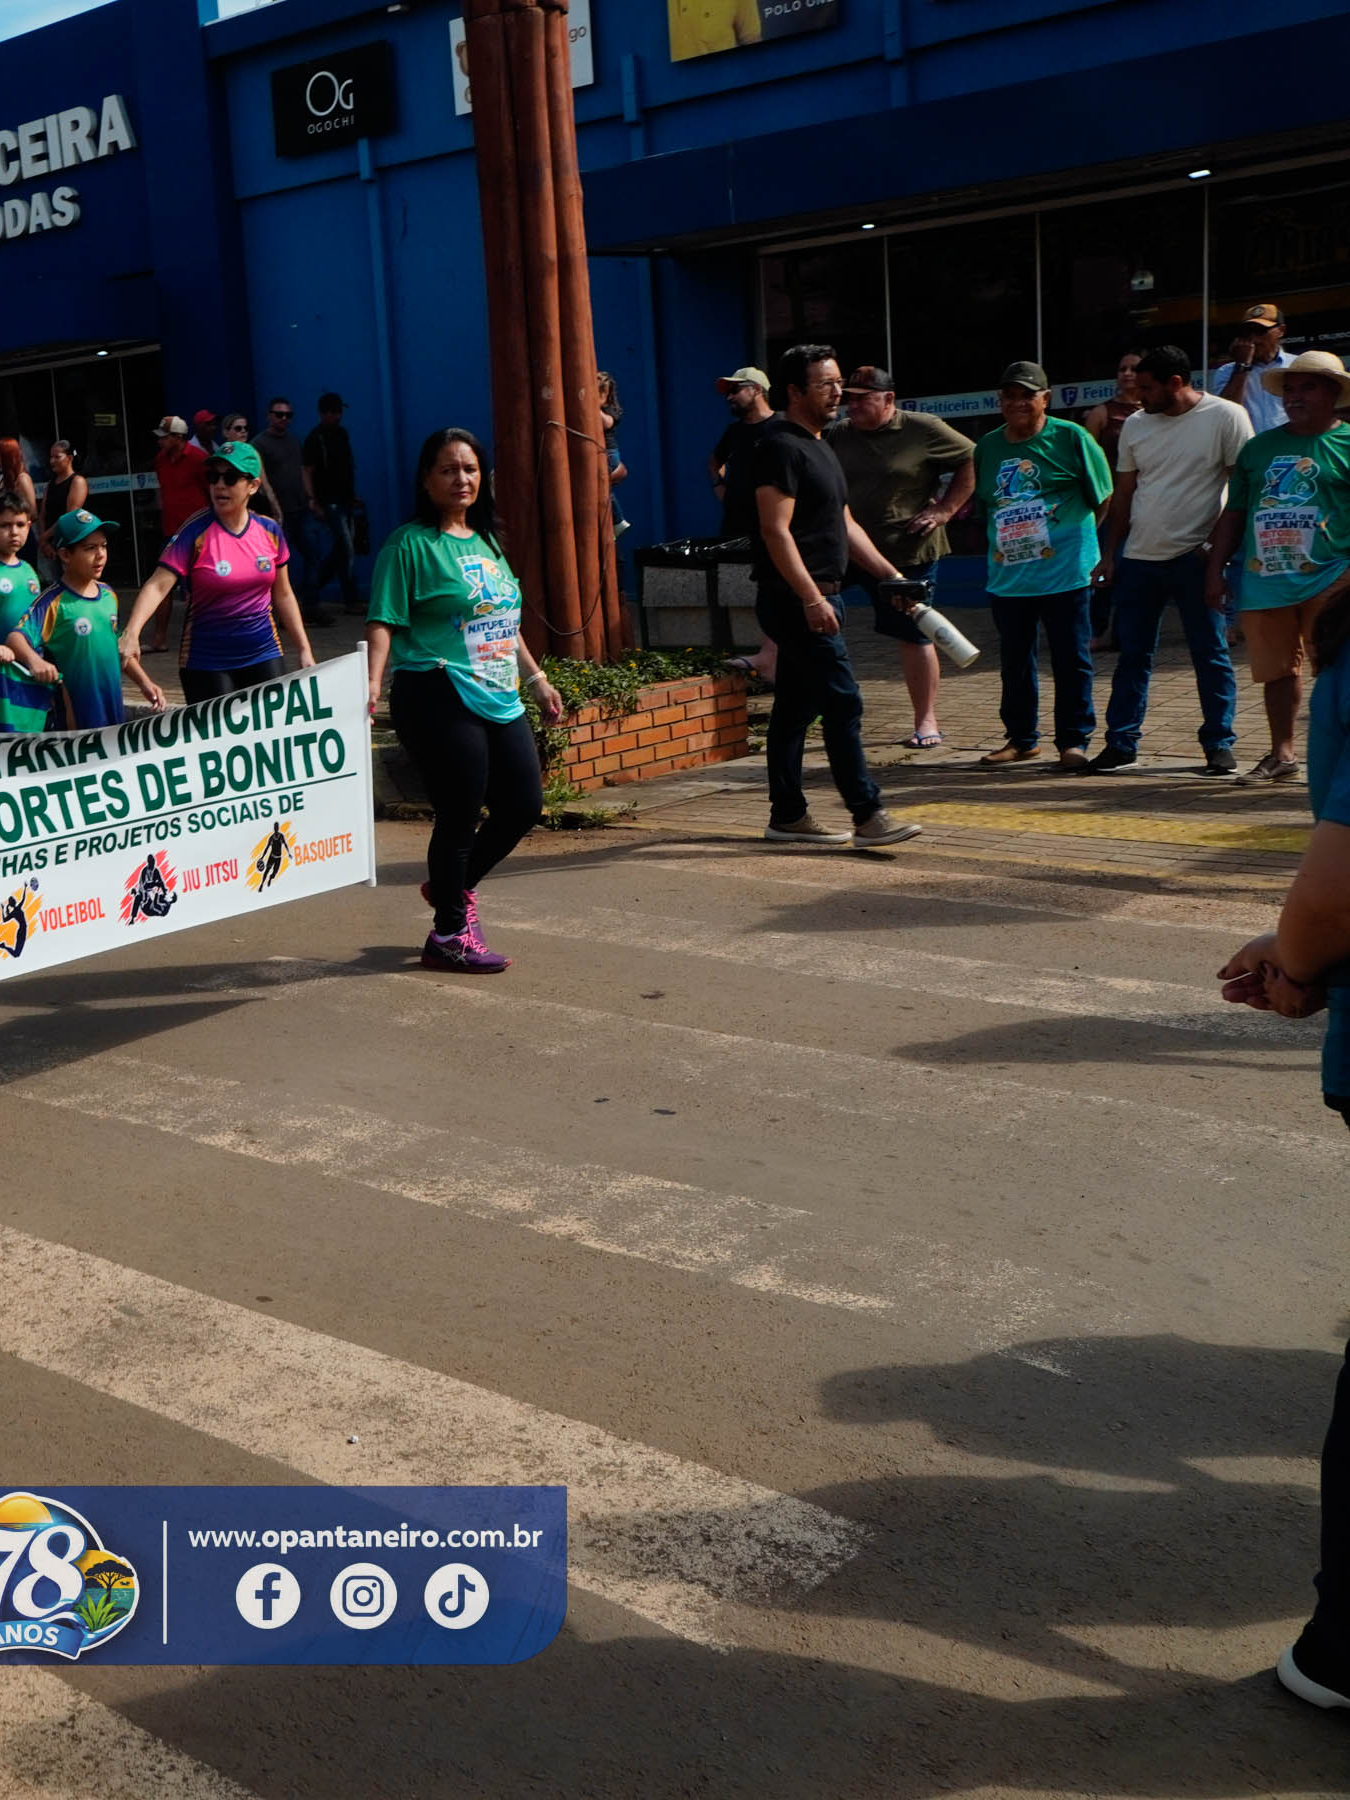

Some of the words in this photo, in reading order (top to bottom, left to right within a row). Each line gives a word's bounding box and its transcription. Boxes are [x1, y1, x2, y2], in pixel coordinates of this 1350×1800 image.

[763, 1, 801, 19] POLO
[307, 115, 354, 134] OGOCHI
[118, 675, 332, 755] MUNICIPAL
[136, 756, 192, 813] DE
[199, 728, 346, 799] BONITO
[54, 845, 68, 865] E
[75, 817, 181, 861] PROJETOS
[188, 798, 272, 834] SOCIAIS
[278, 791, 304, 815] DE
[294, 833, 353, 867] BASQUETE
[182, 869, 200, 893] JIU
[205, 858, 239, 887] JITSU
[39, 897, 105, 932] VOLEIBOL
